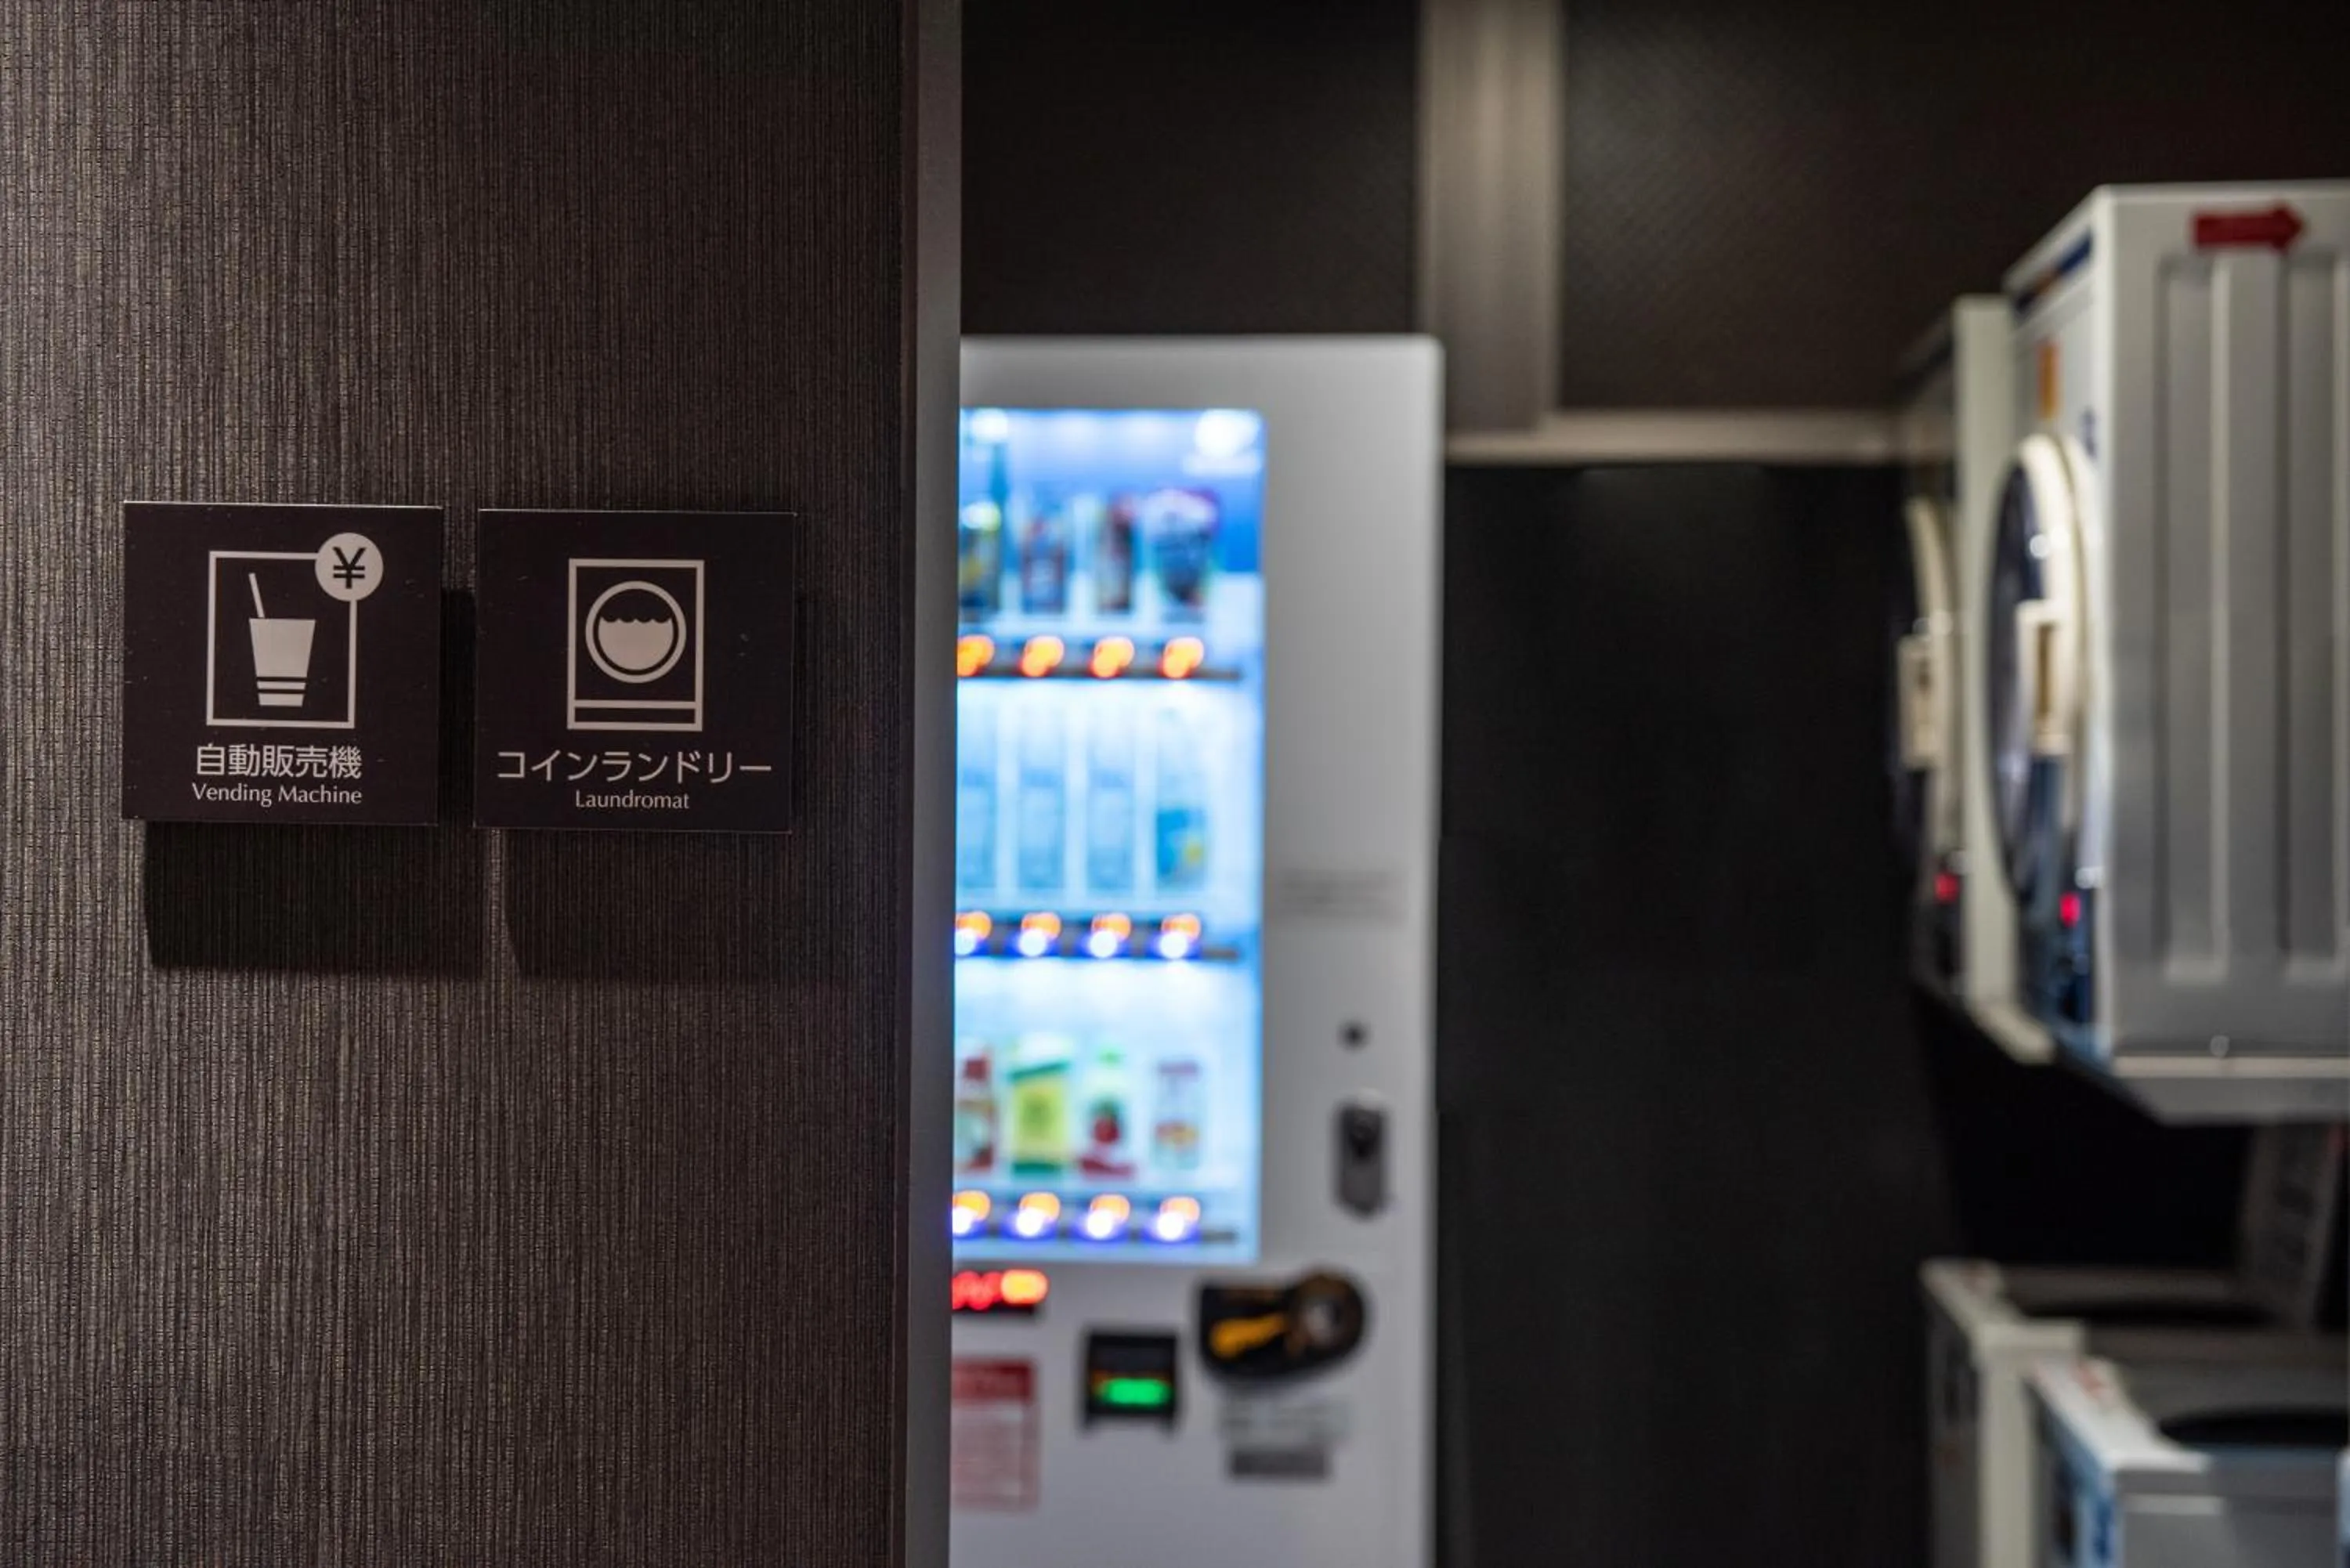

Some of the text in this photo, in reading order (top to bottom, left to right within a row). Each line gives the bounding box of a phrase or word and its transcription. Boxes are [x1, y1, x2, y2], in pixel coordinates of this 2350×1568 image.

[333, 546, 366, 589] ¥
[197, 742, 362, 779] 自動販売機
[497, 750, 772, 783] コインランドリー
[192, 782, 362, 807] Vending Machine
[576, 789, 689, 809] Laundromat
